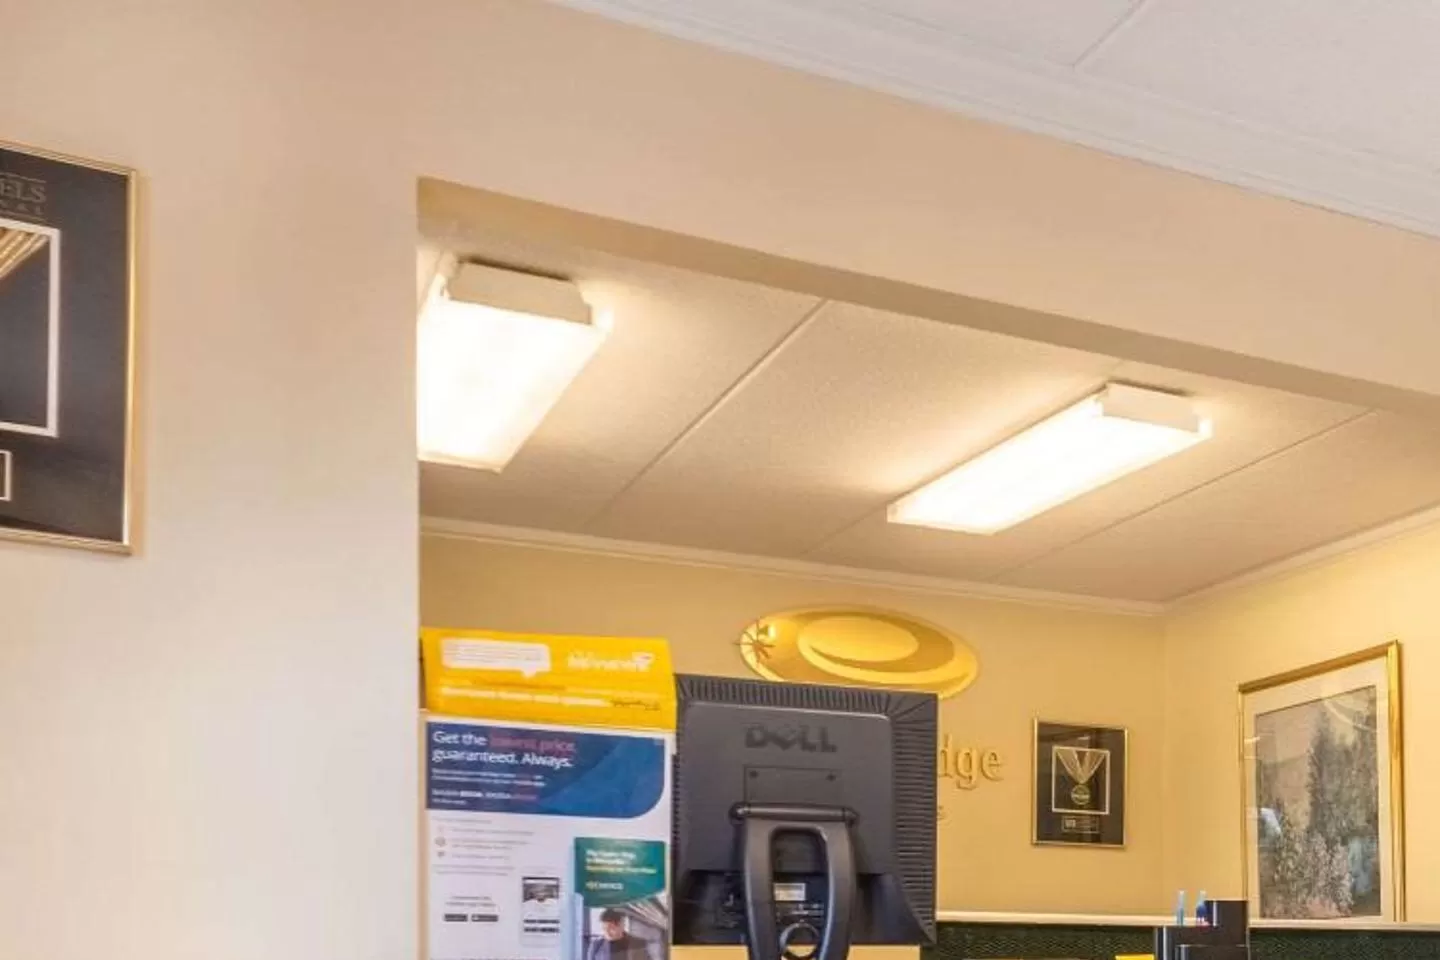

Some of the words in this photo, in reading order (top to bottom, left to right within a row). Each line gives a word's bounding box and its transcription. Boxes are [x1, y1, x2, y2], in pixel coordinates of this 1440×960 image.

[432, 731, 459, 744] Get
[461, 733, 488, 746] the
[745, 726, 838, 753] DELL
[521, 752, 574, 770] Always.
